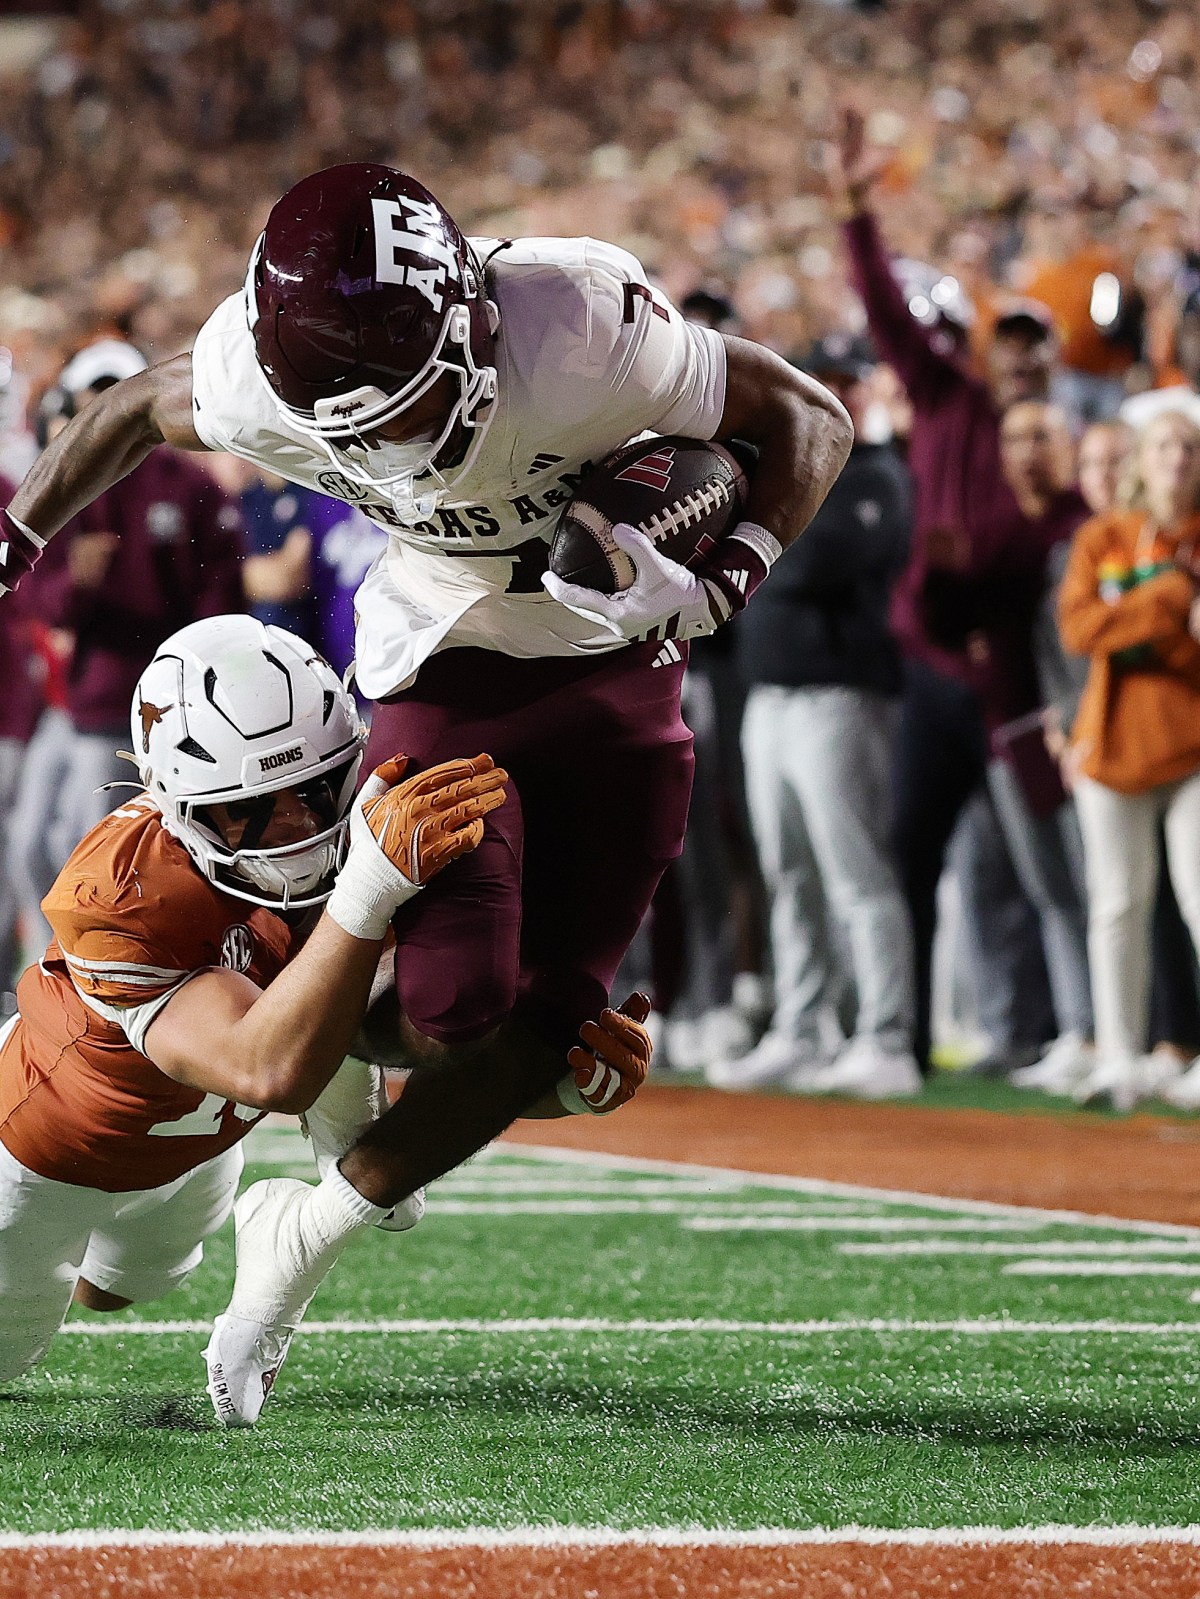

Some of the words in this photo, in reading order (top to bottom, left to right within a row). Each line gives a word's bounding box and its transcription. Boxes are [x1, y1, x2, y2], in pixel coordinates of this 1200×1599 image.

[622, 282, 671, 324] 7
[258, 746, 304, 772] HORNS
[214, 1382, 229, 1398] EM
[217, 1397, 236, 1415] OFF
